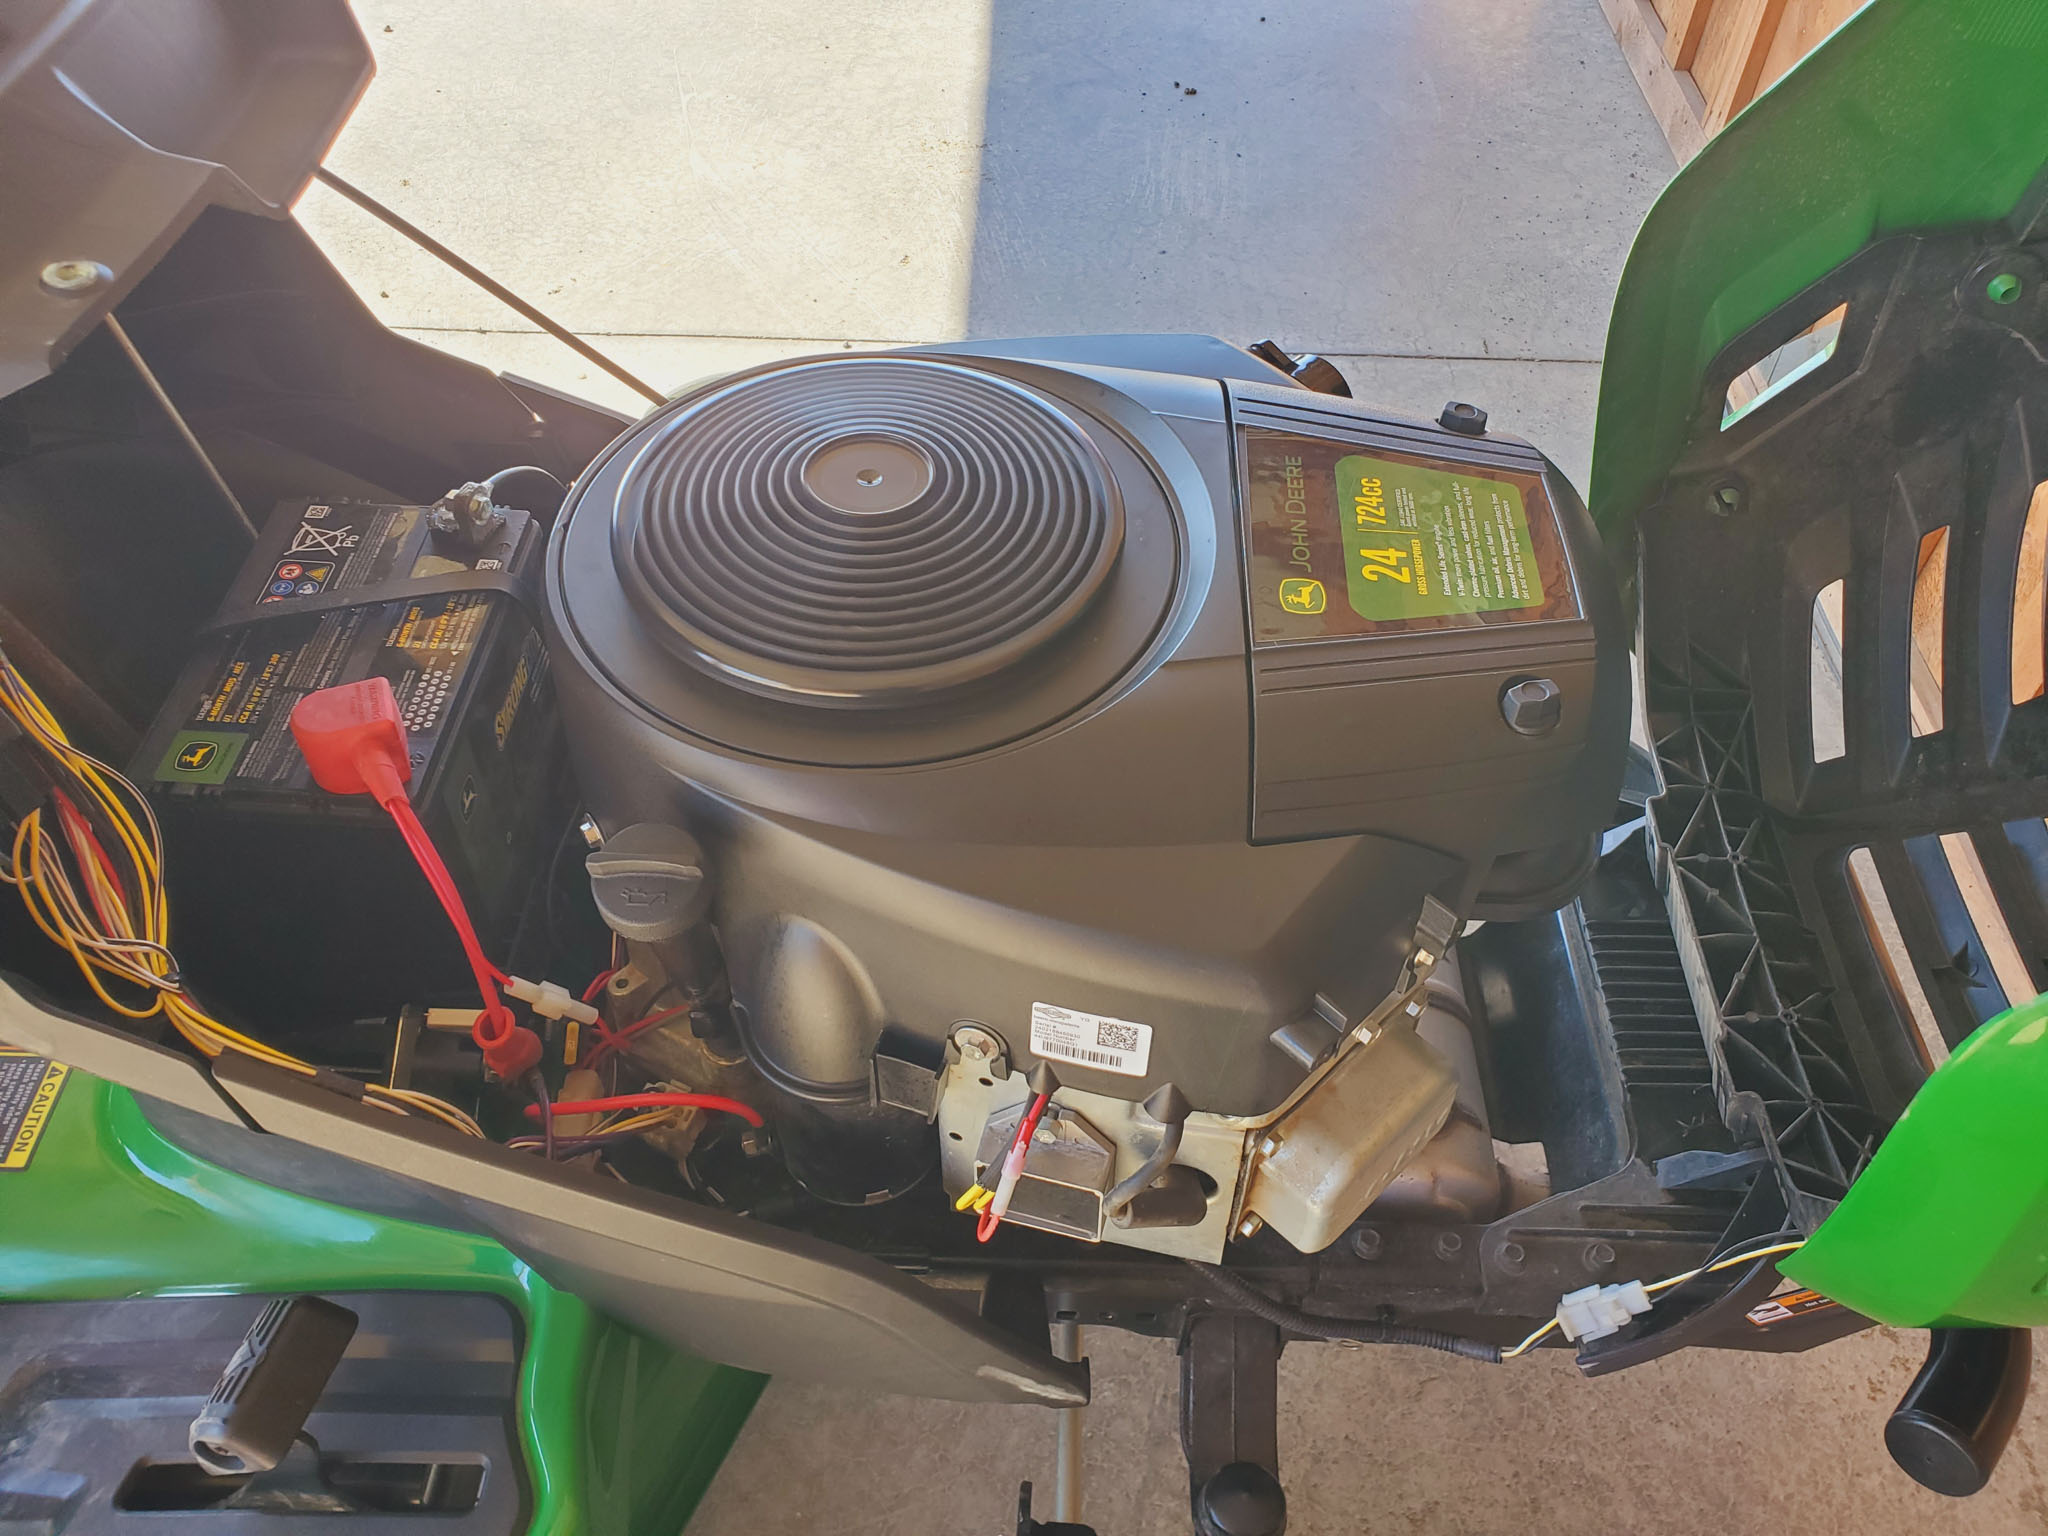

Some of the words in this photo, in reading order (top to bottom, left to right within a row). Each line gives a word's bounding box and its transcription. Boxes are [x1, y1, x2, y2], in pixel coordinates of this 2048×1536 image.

[1284, 455, 1306, 514] DEERE
[1354, 477, 1387, 525] 724cc
[1444, 505, 1453, 525] vibration
[1494, 505, 1502, 523] protects
[1503, 500, 1514, 529] performance
[343, 535, 360, 547] Pb
[1461, 521, 1470, 541] cast-iron
[1470, 520, 1478, 539] reduced
[1498, 525, 1510, 555] Management
[1510, 529, 1520, 553] long-term
[1289, 519, 1312, 572] JOHN
[1452, 549, 1460, 562] power
[1488, 546, 1496, 555] and
[1360, 547, 1412, 584] 24
[1411, 539, 1425, 576] HORSEPOWER
[1476, 548, 1486, 574] lubrication
[1468, 559, 1480, 597] Chrome-plated
[1516, 562, 1525, 578] debris
[1418, 576, 1428, 595] GROSS
[1442, 571, 1451, 595] Extended
[1482, 576, 1491, 597] pressure
[1495, 575, 1504, 598] Premium
[1509, 574, 1520, 598] Advanced
[238, 712, 250, 724] CCA
[31, 1064, 45, 1080] Read
[11, 1085, 25, 1104] safety
[14, 1082, 55, 1152] CAUTION
[2, 1118, 17, 1142] manual
